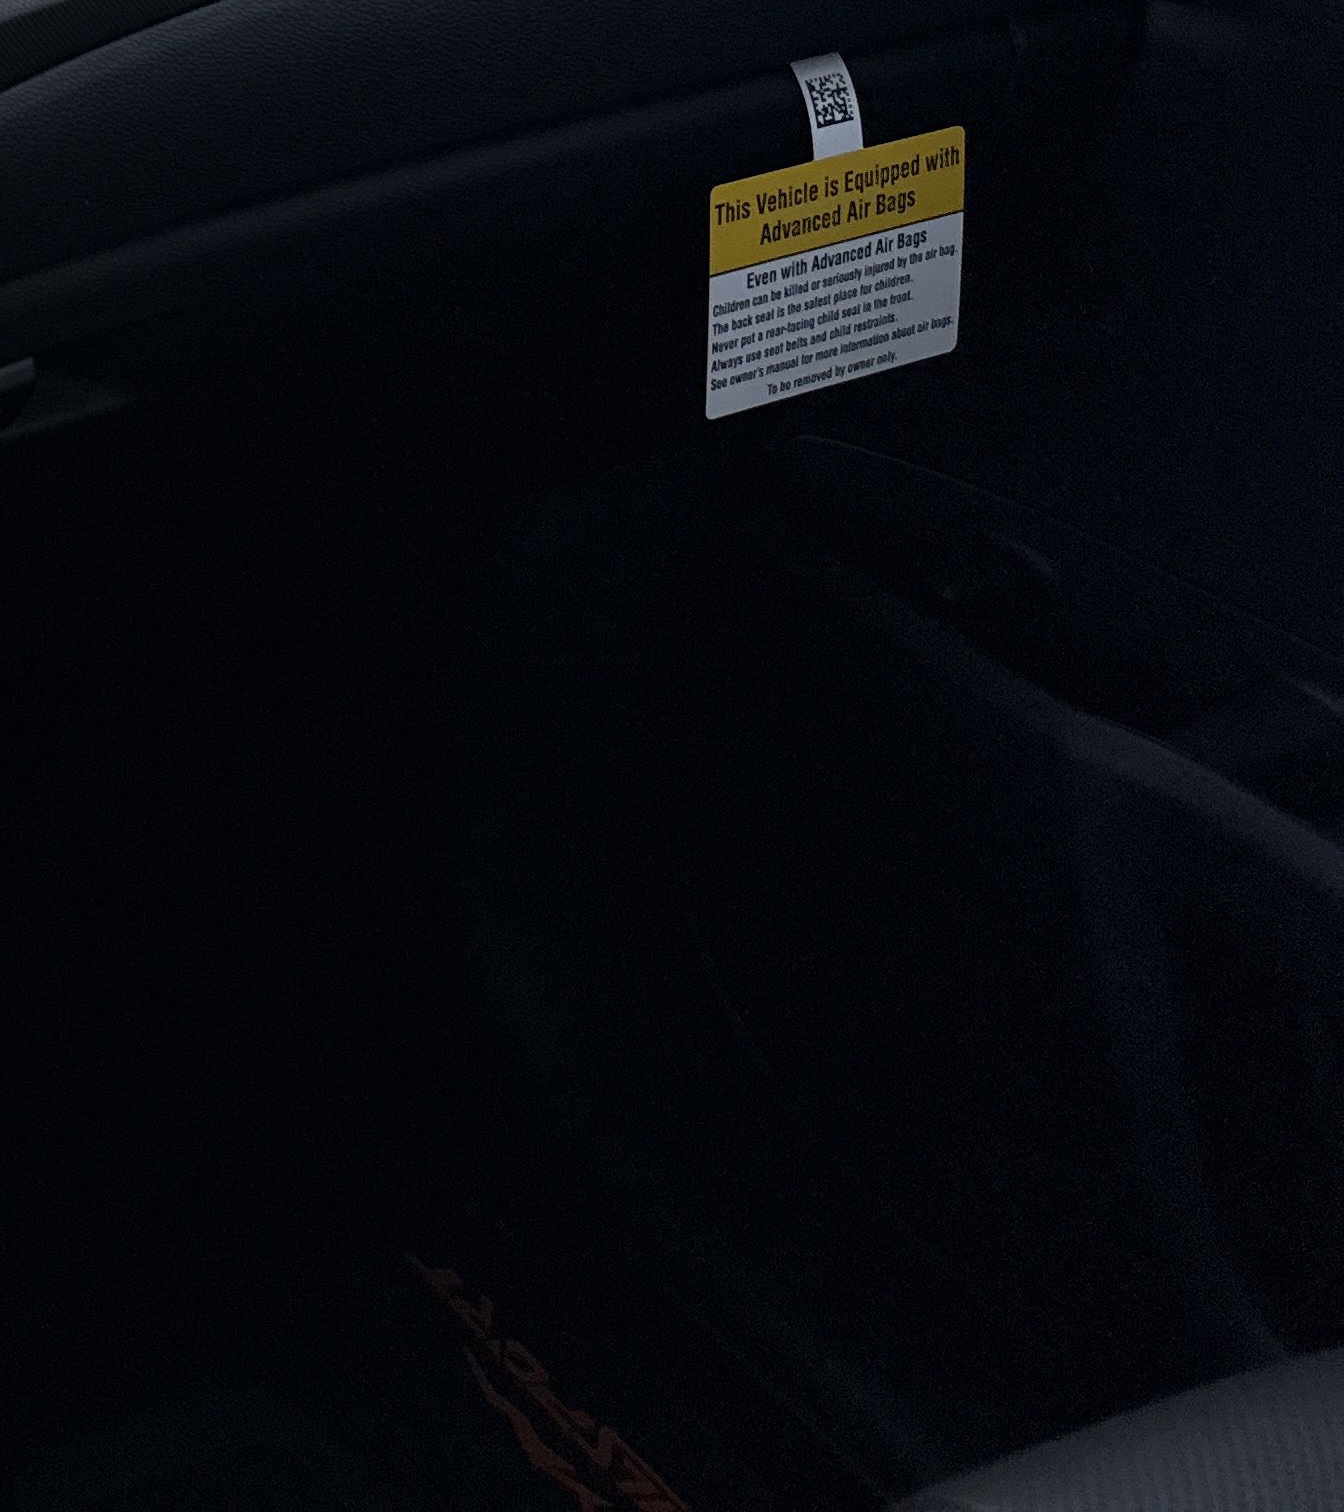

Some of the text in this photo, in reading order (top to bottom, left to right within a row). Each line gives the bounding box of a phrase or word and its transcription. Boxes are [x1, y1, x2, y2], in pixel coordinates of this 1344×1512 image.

[715, 144, 961, 227] This Vehicle is Equipped with
[759, 189, 917, 246] Advanced Air Bags
[712, 244, 958, 318] Children can be killed or seriously injured by the air bag.
[746, 229, 928, 289] Even with Advanced Air Bags
[712, 273, 914, 337] The back seat is the safest place for children.
[712, 338, 739, 355] Never
[740, 332, 756, 349] put
[758, 331, 763, 342] a
[765, 316, 815, 338] rear-facing
[817, 308, 840, 326] child
[841, 303, 861, 319] seat
[863, 299, 872, 313] in
[873, 296, 888, 311] the
[710, 354, 743, 374] Always
[745, 349, 762, 364] use
[763, 342, 784, 359] seat
[785, 335, 808, 353] belts
[809, 330, 827, 346] and
[829, 324, 851, 341] child
[710, 377, 727, 392] See
[730, 365, 765, 387] owner's
[765, 355, 799, 375] manual
[801, 352, 814, 366] for
[815, 347, 838, 363] more
[840, 331, 890, 355] information
[891, 323, 916, 340] about
[917, 320, 930, 334] air
[767, 383, 778, 396] To
[780, 379, 791, 393] be
[793, 368, 833, 388] removed
[834, 364, 846, 379] by
[847, 356, 875, 374] owner
